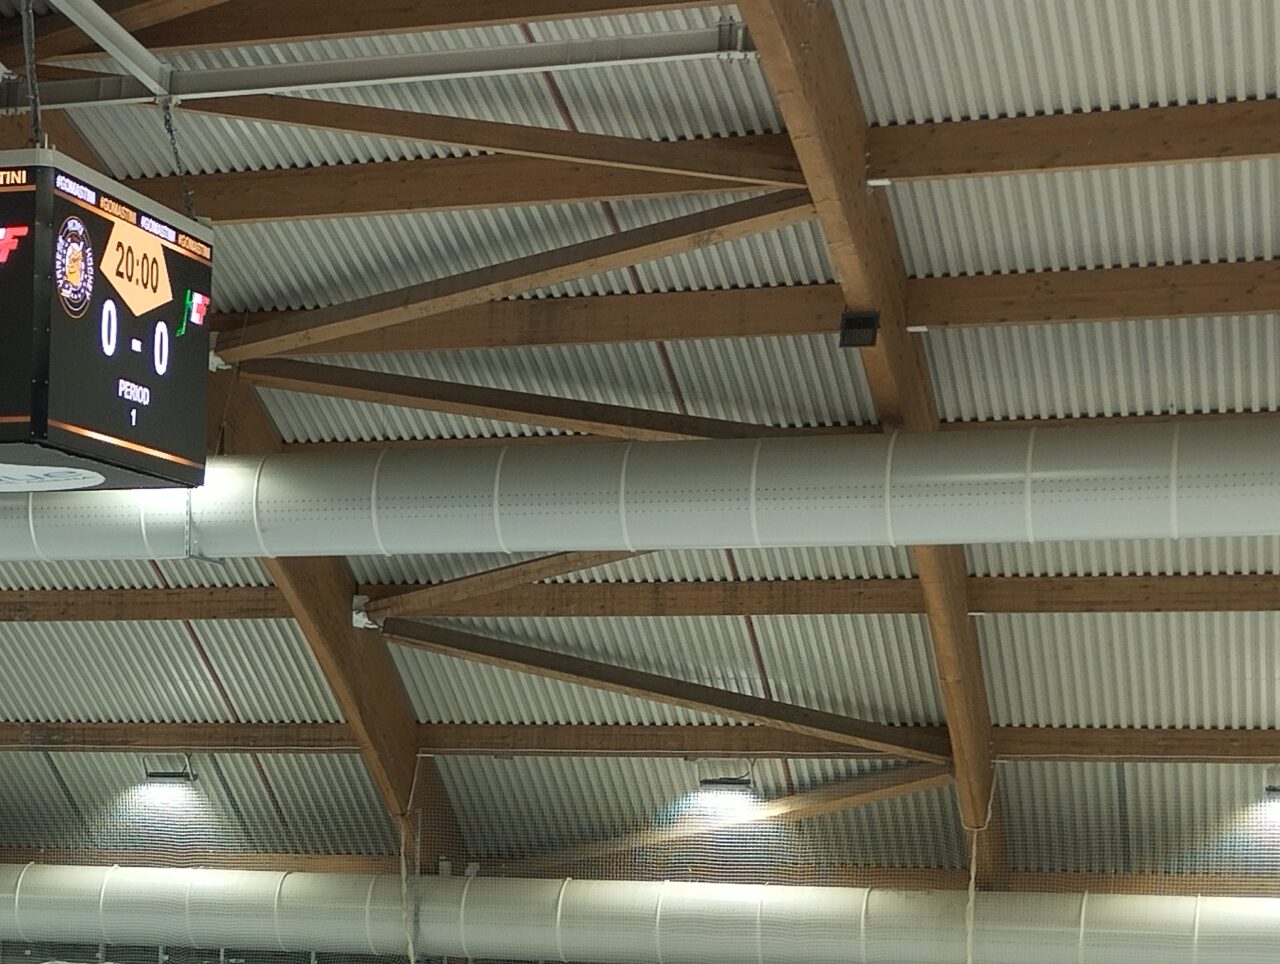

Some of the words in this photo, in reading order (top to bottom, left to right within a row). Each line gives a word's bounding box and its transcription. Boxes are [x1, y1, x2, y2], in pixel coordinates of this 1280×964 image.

[115, 241, 159, 293] 20:00
[101, 299, 118, 357] 0
[153, 320, 169, 375] 0
[118, 378, 150, 406] PERIOD
[130, 408, 137, 426] 1
